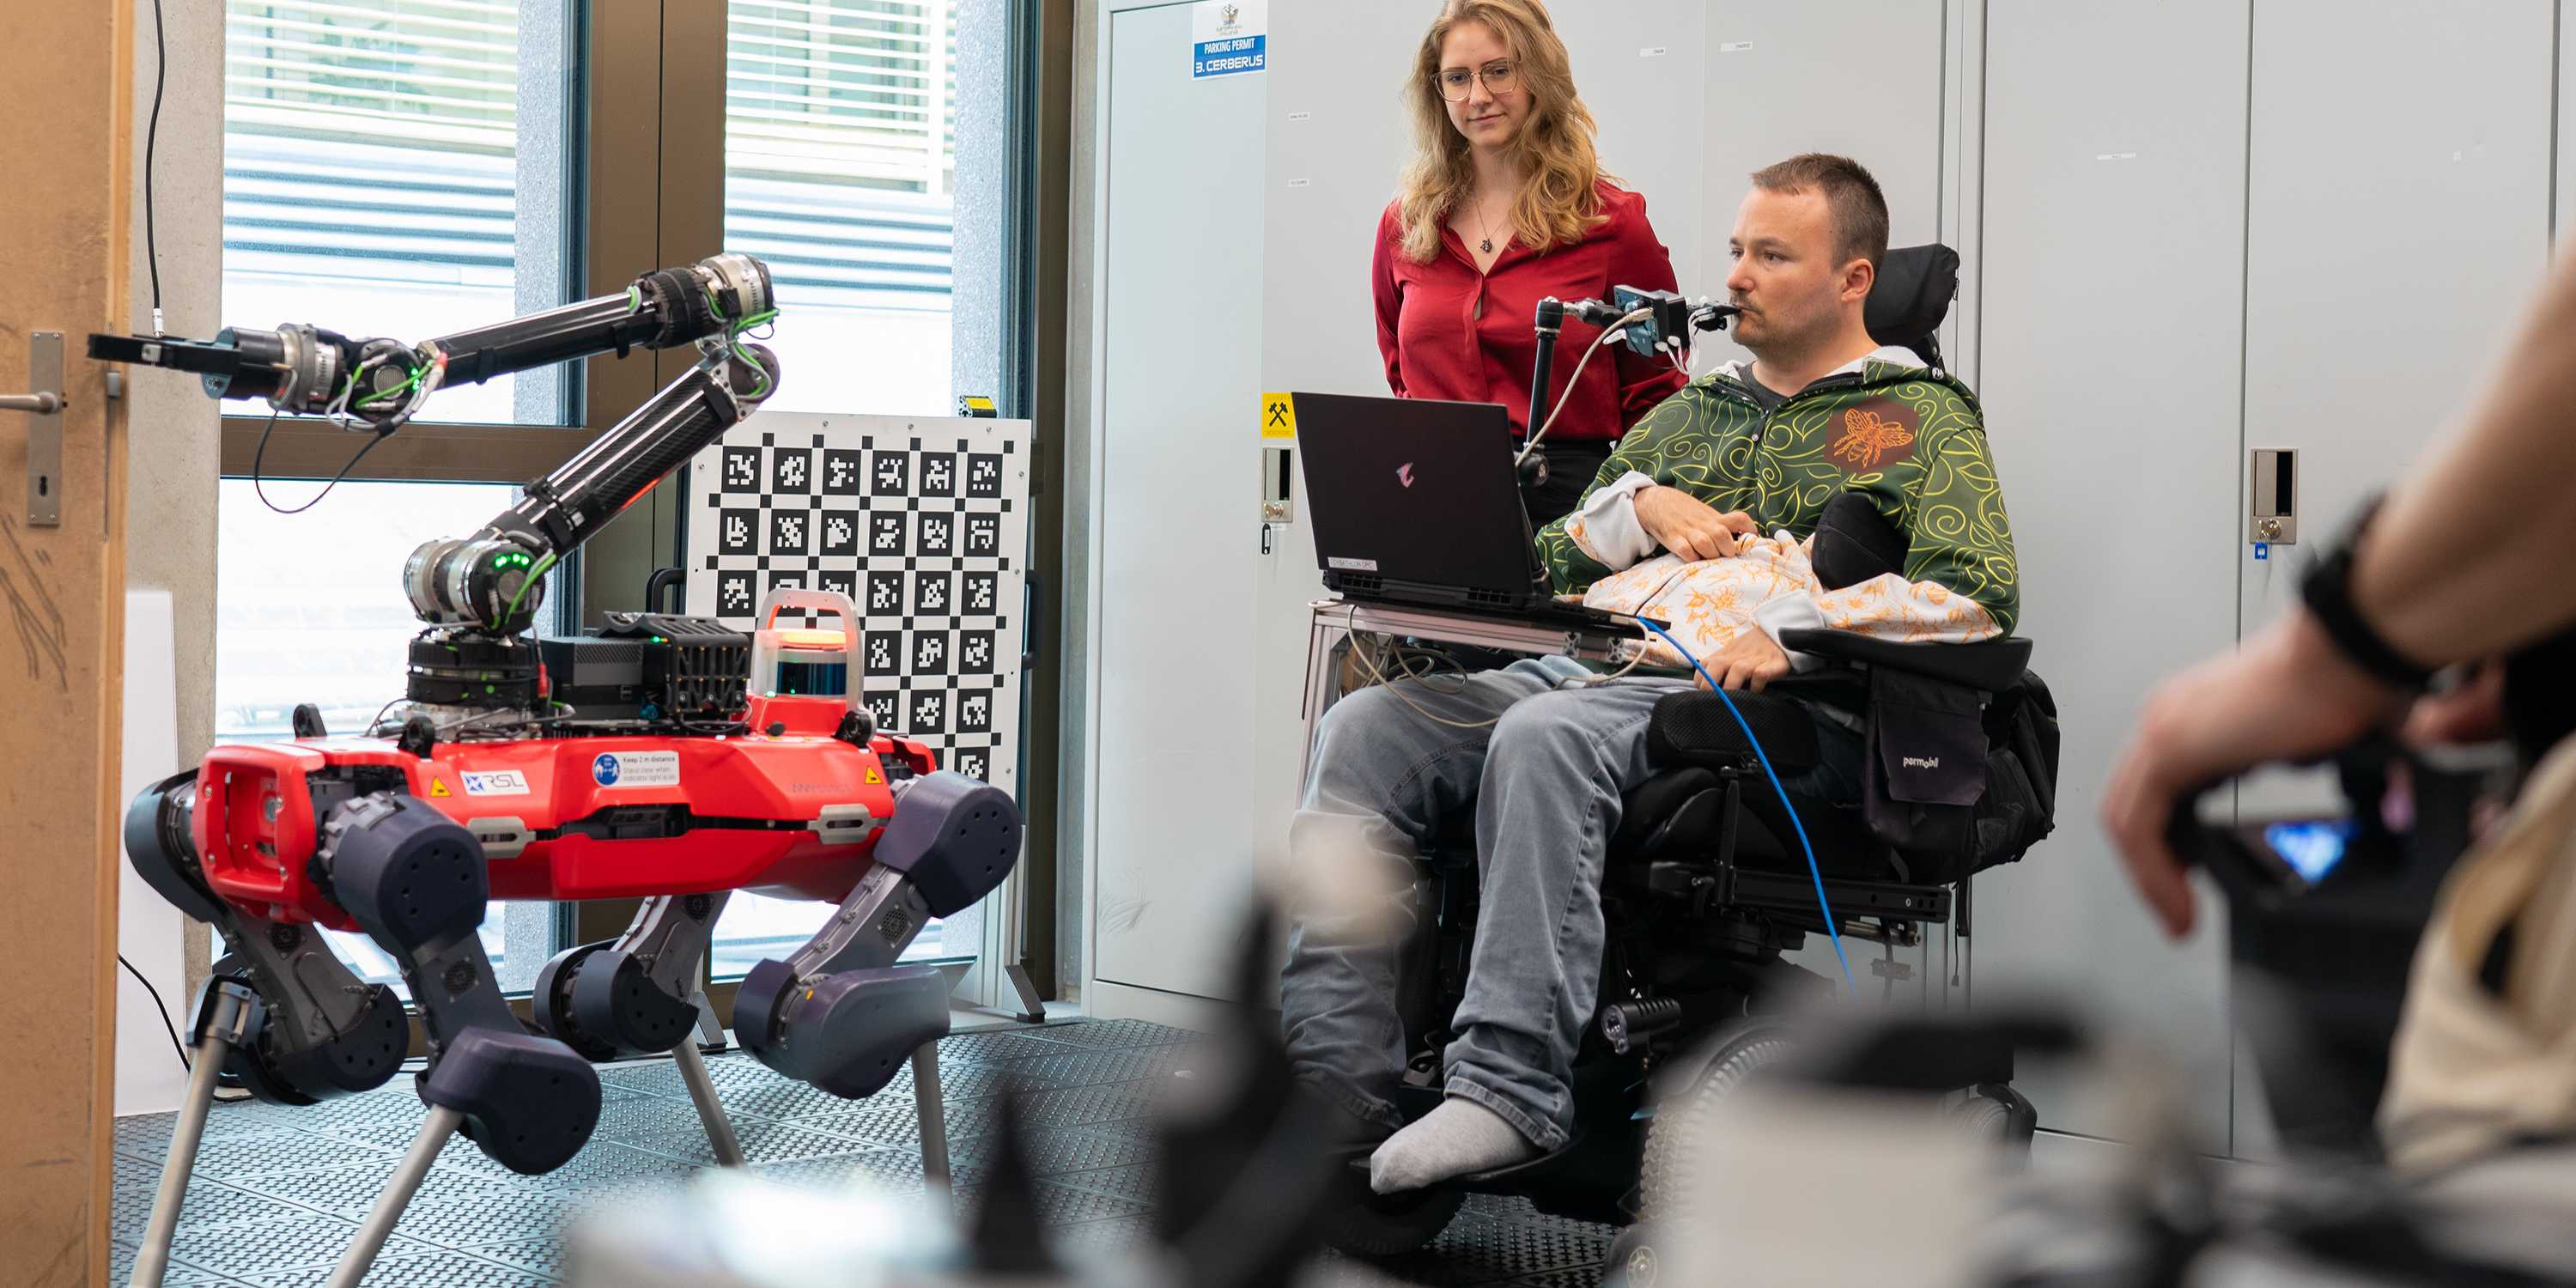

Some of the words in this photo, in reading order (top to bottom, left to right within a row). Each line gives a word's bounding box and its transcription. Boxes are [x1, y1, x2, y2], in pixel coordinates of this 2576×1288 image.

[1204, 40, 1230, 55] PARKING
[1232, 38, 1255, 52] PERMIT
[1206, 54, 1264, 71] CERBERUS
[1903, 756, 1939, 769] permobil
[483, 774, 524, 787] RSL
